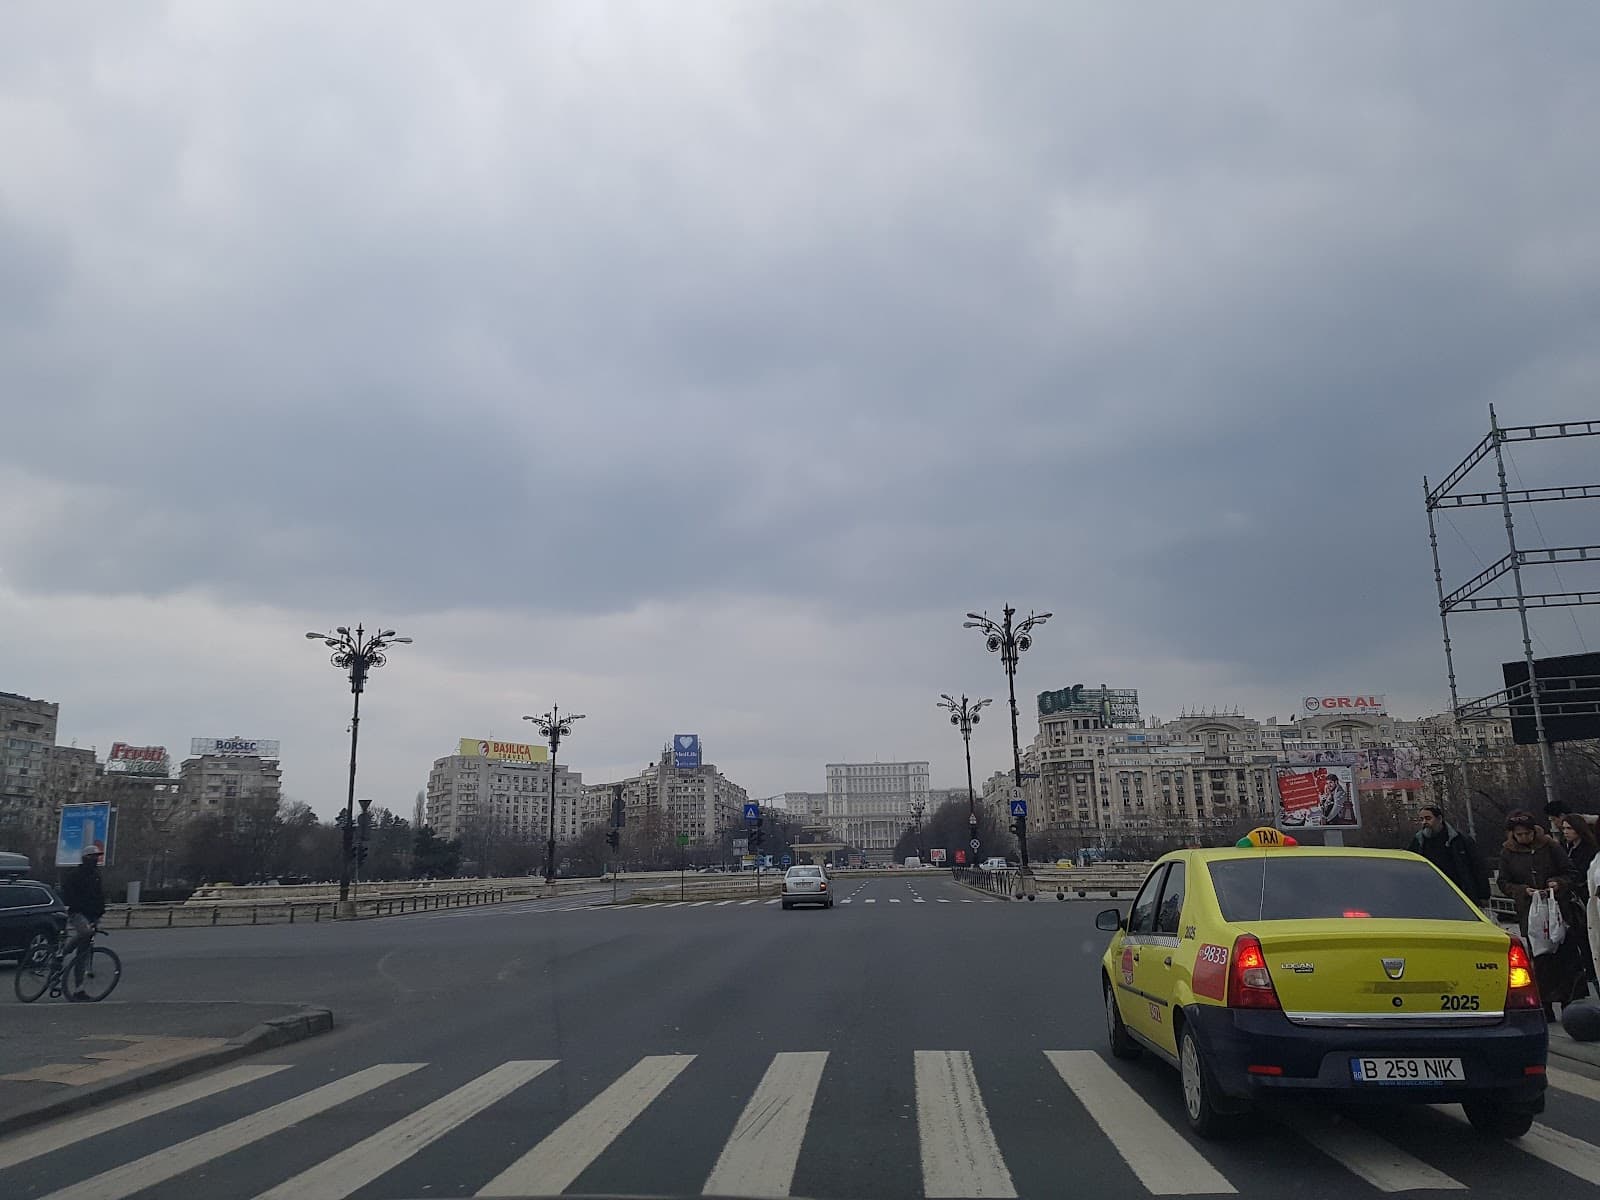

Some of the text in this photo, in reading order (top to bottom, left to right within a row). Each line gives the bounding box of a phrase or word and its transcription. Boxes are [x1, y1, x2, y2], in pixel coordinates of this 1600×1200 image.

[1322, 697, 1382, 708] GRAL
[216, 740, 257, 751] BORSEC
[494, 743, 531, 760] BASILICA
[1256, 830, 1279, 844] TAXI
[1202, 946, 1227, 965] 9833
[1440, 994, 1480, 1011] 2025
[1363, 1059, 1456, 1079] B 259 NIK
